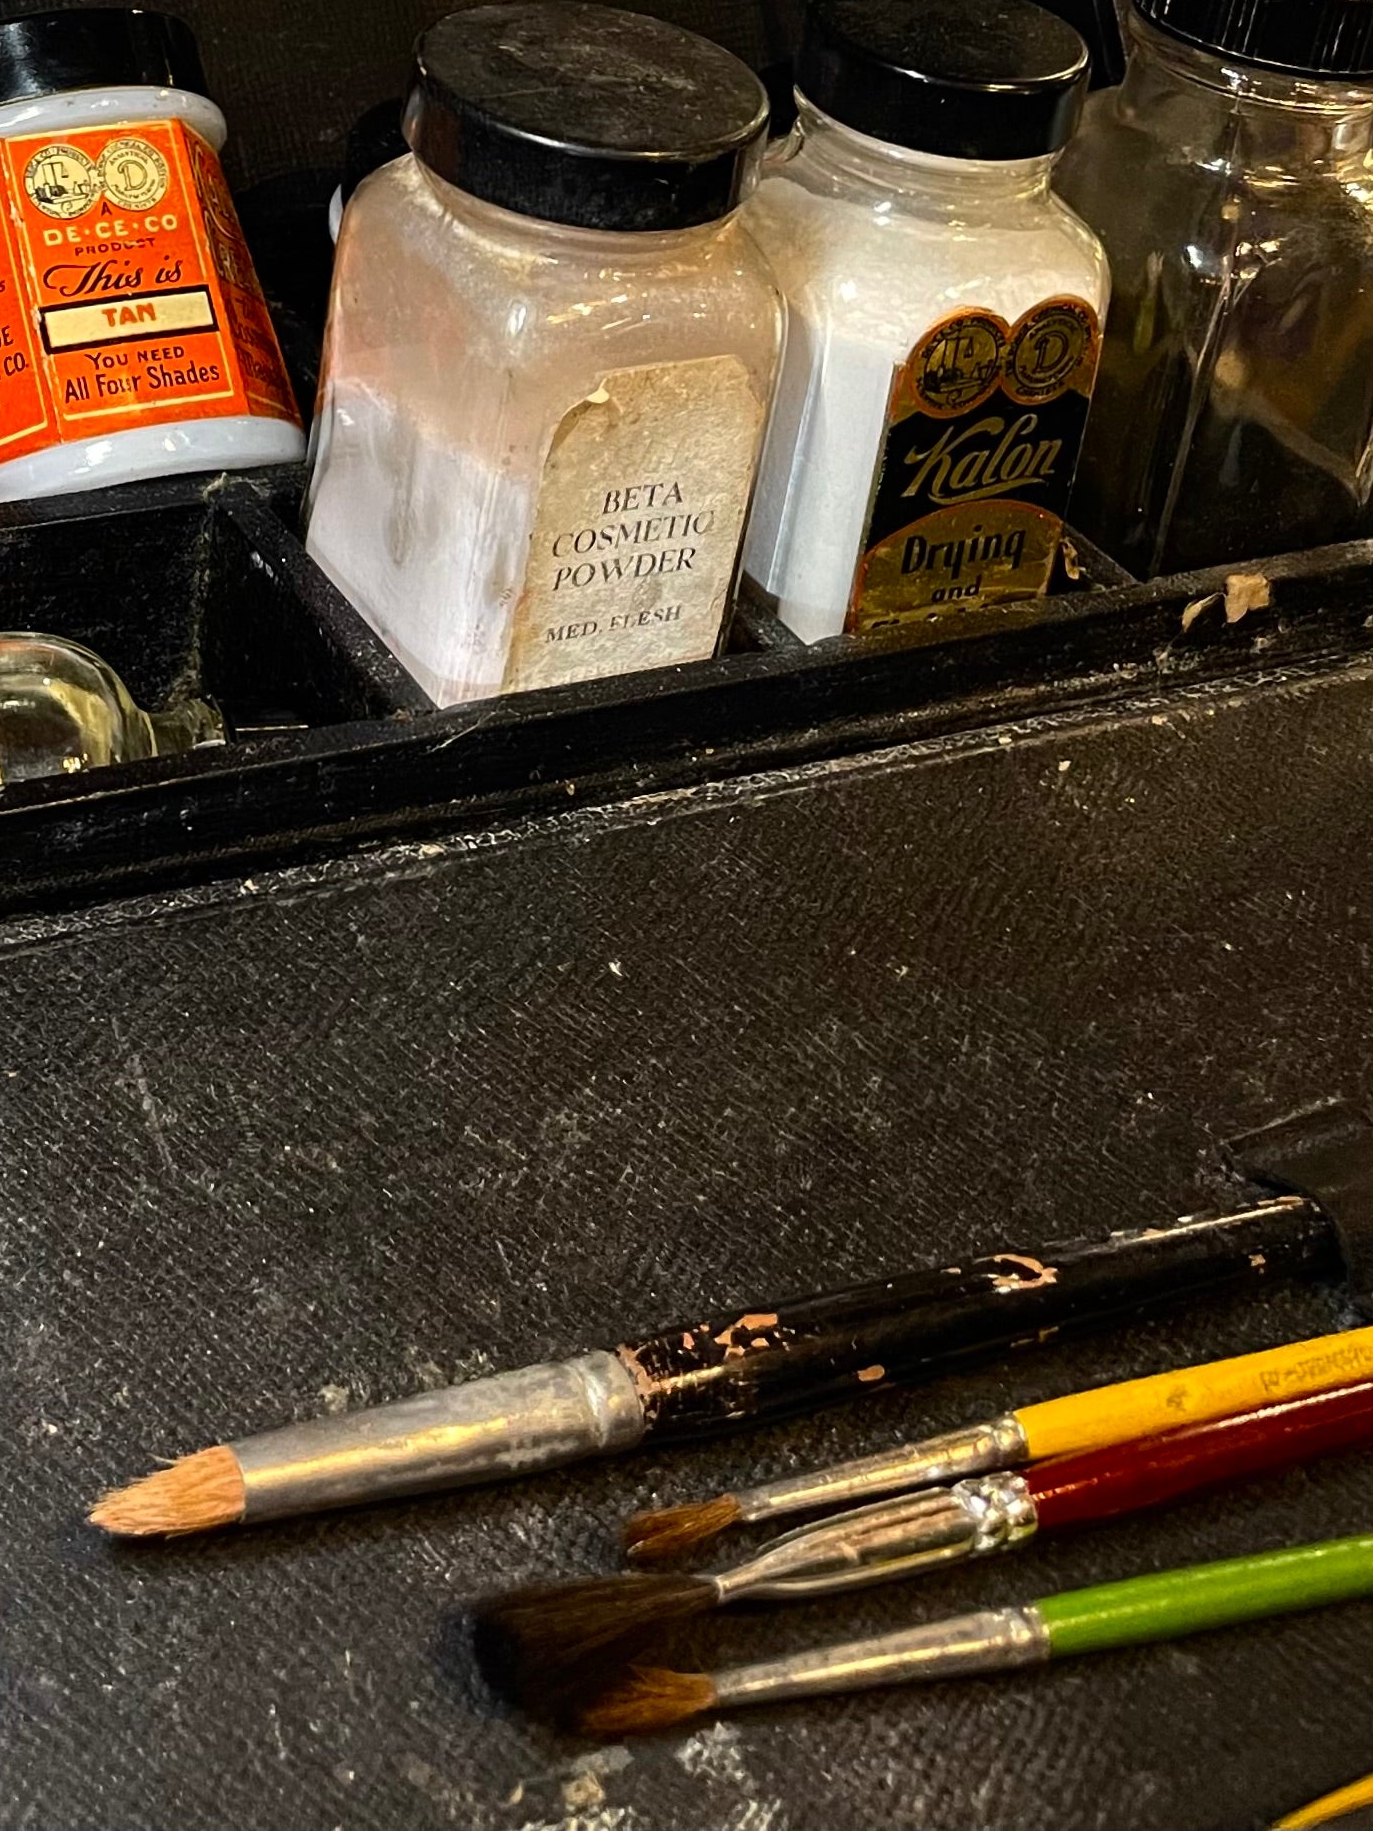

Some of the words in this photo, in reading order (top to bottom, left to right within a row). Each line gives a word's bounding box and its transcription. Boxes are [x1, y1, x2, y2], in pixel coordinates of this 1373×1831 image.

[101, 201, 113, 217] A
[74, 238, 156, 257] PRODUCT
[43, 260, 141, 298] This
[155, 255, 183, 283] is
[101, 303, 157, 329] TAN
[85, 351, 129, 372] YOU
[137, 346, 185, 364] NEED
[64, 379, 88, 404] All
[97, 372, 142, 397] Four
[146, 364, 221, 390] Shades
[900, 413, 1063, 505] Kalon
[602, 481, 684, 515] BETA
[552, 510, 716, 558] COSMETIC
[553, 546, 697, 591] POWDER
[900, 524, 1027, 581] Drying
[931, 574, 981, 603] and
[544, 620, 603, 644] MED.
